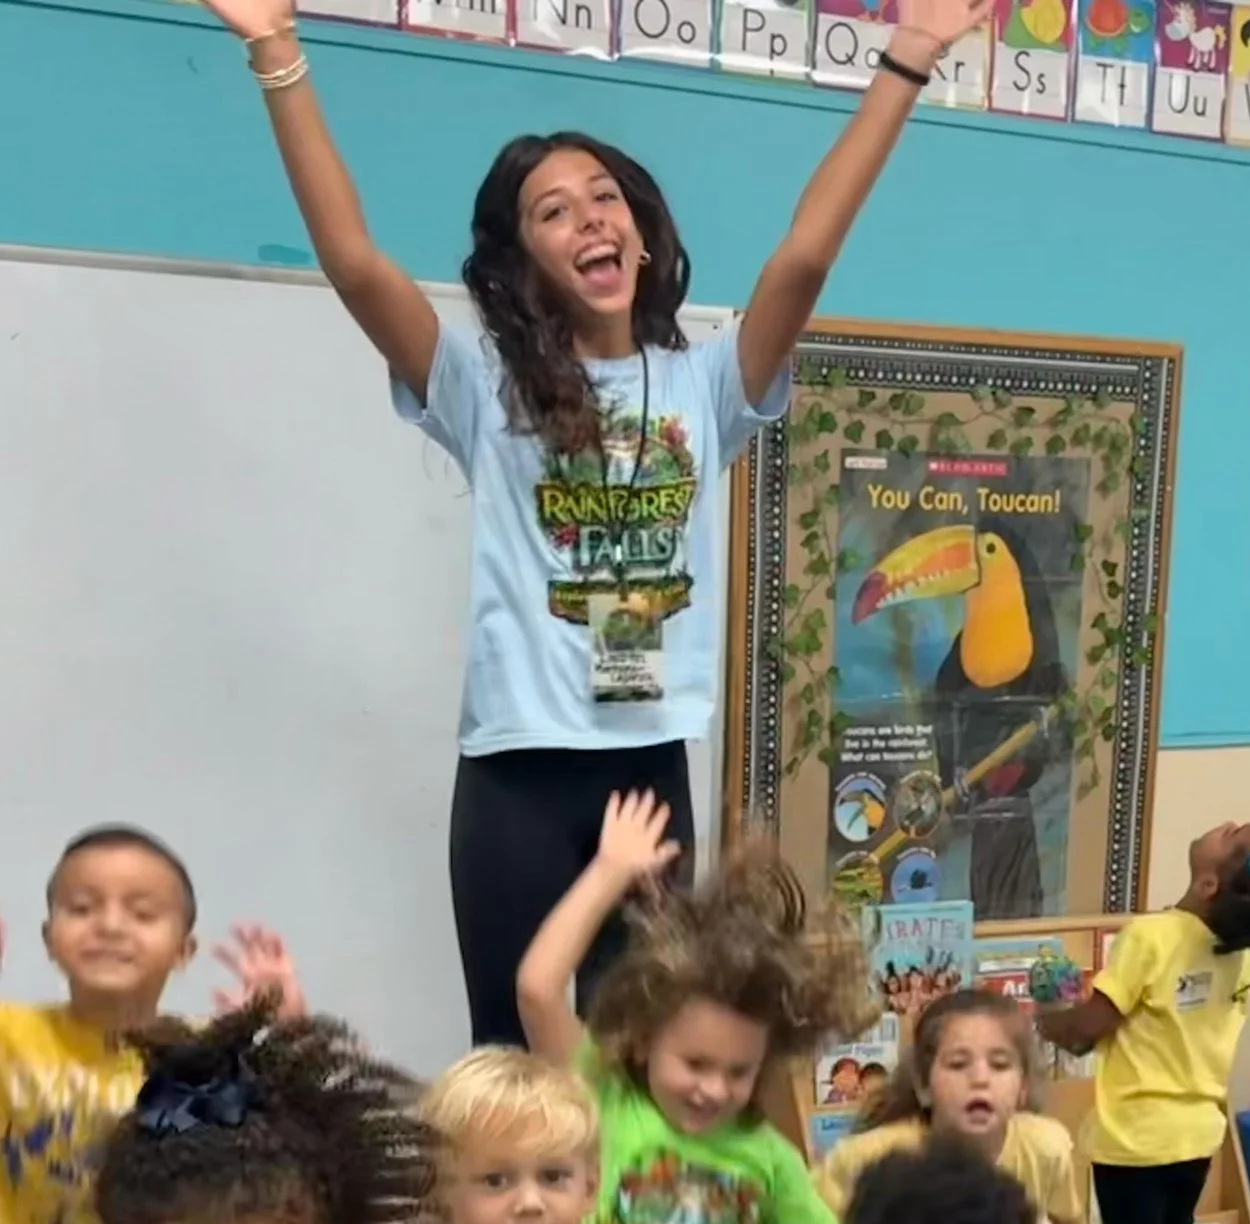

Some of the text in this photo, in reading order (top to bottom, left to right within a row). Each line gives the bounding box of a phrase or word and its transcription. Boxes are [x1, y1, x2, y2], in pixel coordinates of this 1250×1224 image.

[634, 0, 696, 44] Oo
[741, 8, 788, 76] Pp
[1012, 50, 1047, 95] Ss
[1095, 62, 1128, 106] Tt
[1167, 73, 1207, 117] Uu
[542, 485, 696, 523] RAINFOREST
[868, 484, 1061, 515] You Can, Toucan!
[579, 526, 676, 567] FALLS
